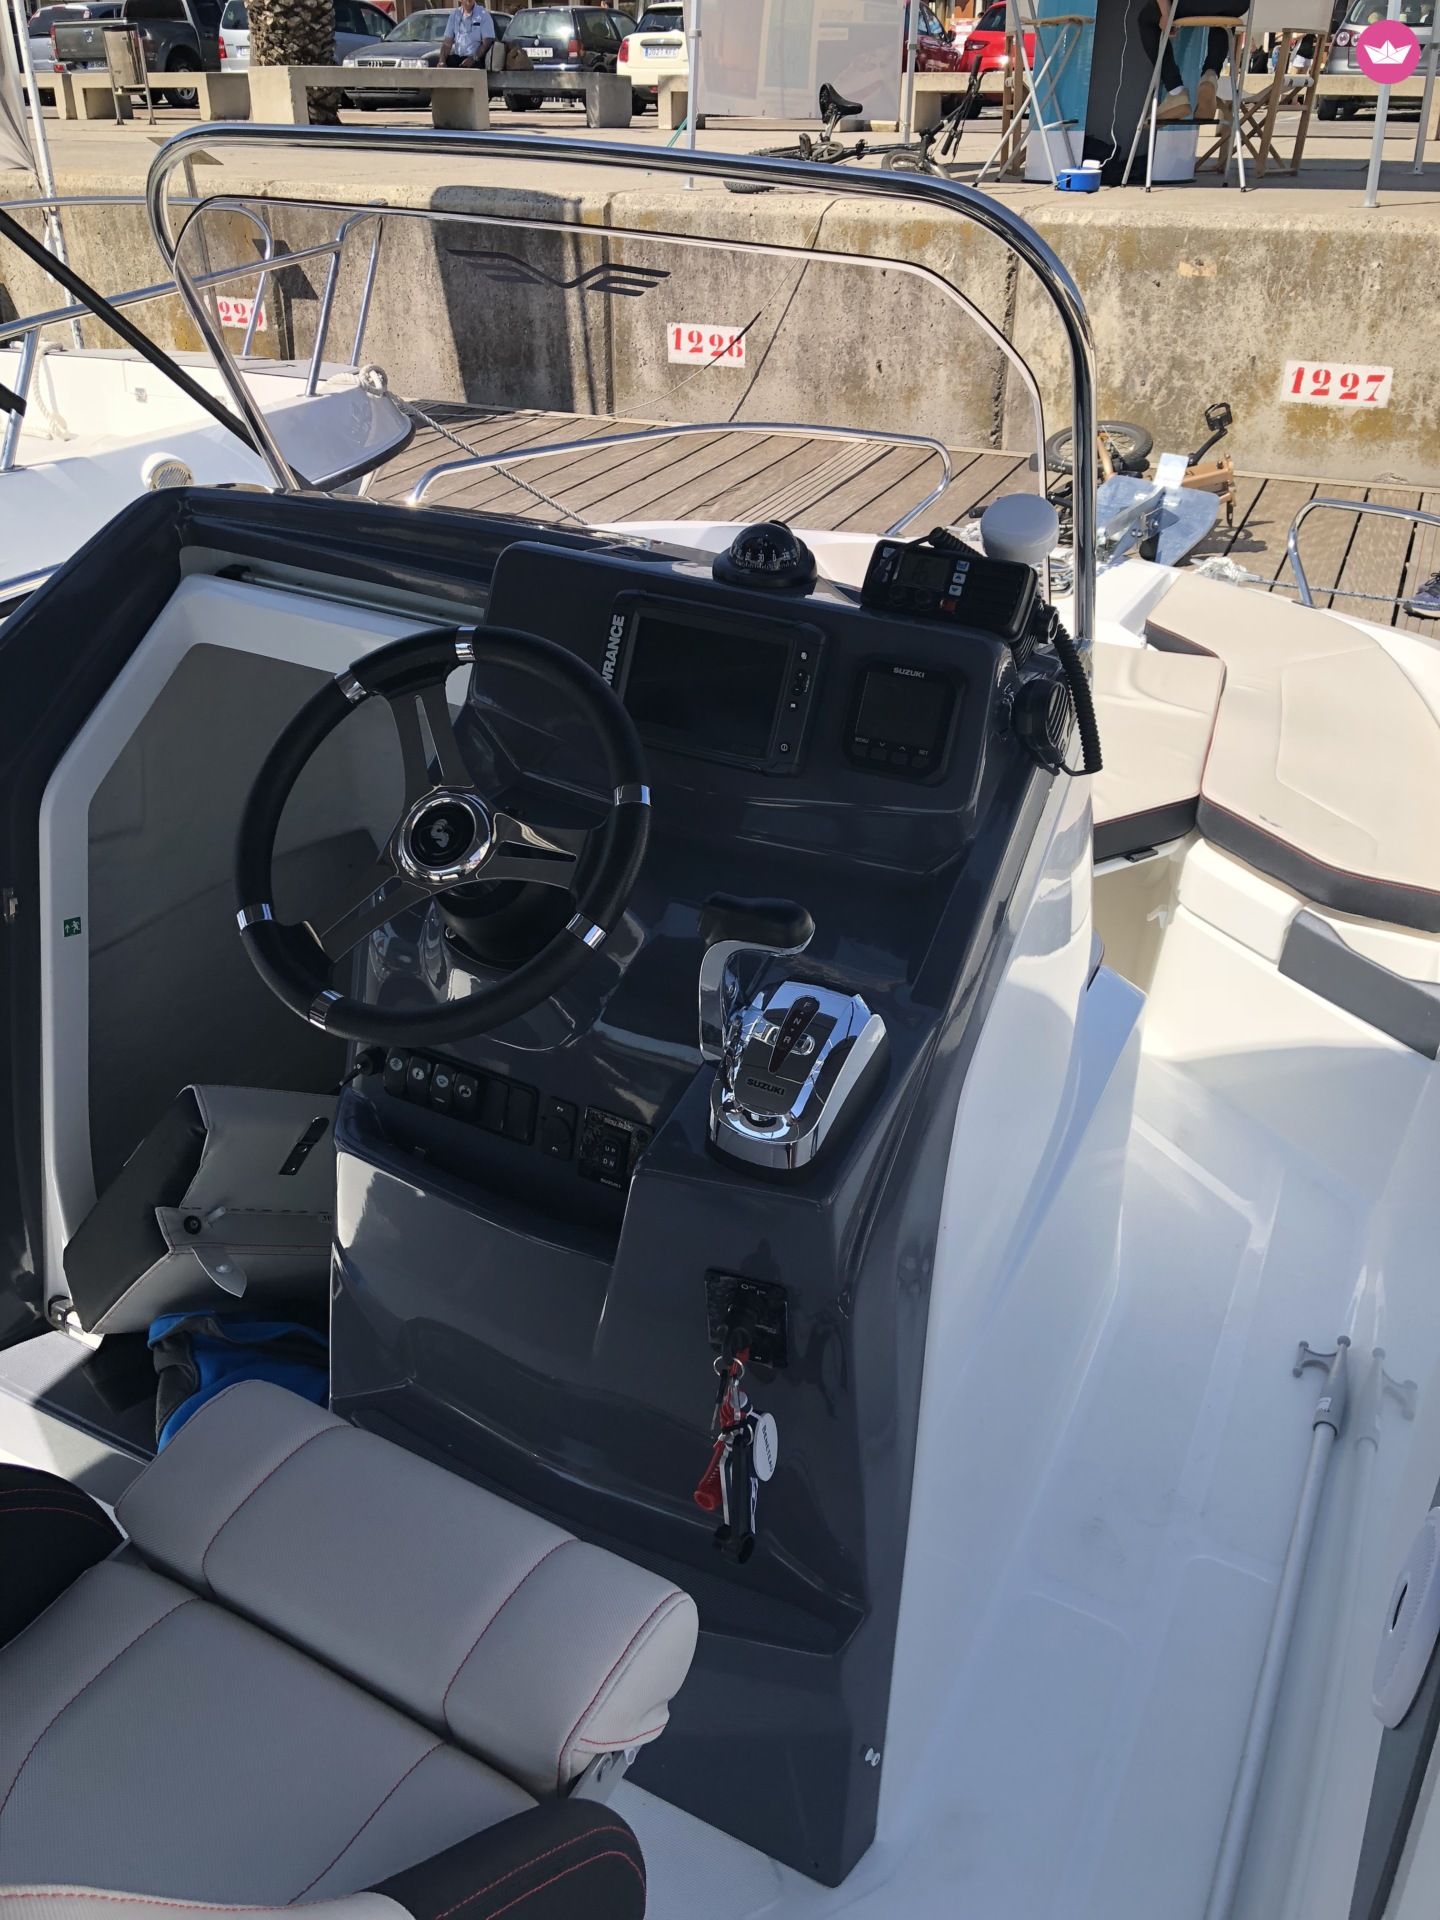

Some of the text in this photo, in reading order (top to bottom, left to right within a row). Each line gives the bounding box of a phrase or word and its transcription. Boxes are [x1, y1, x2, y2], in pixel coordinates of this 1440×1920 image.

[1291, 367, 1386, 402] 1227
[602, 614, 625, 686] WRANCE
[893, 667, 925, 678] SUZUKI
[793, 1018, 802, 1026] N
[783, 1036, 792, 1044] R
[746, 1079, 785, 1096] SUZUKI
